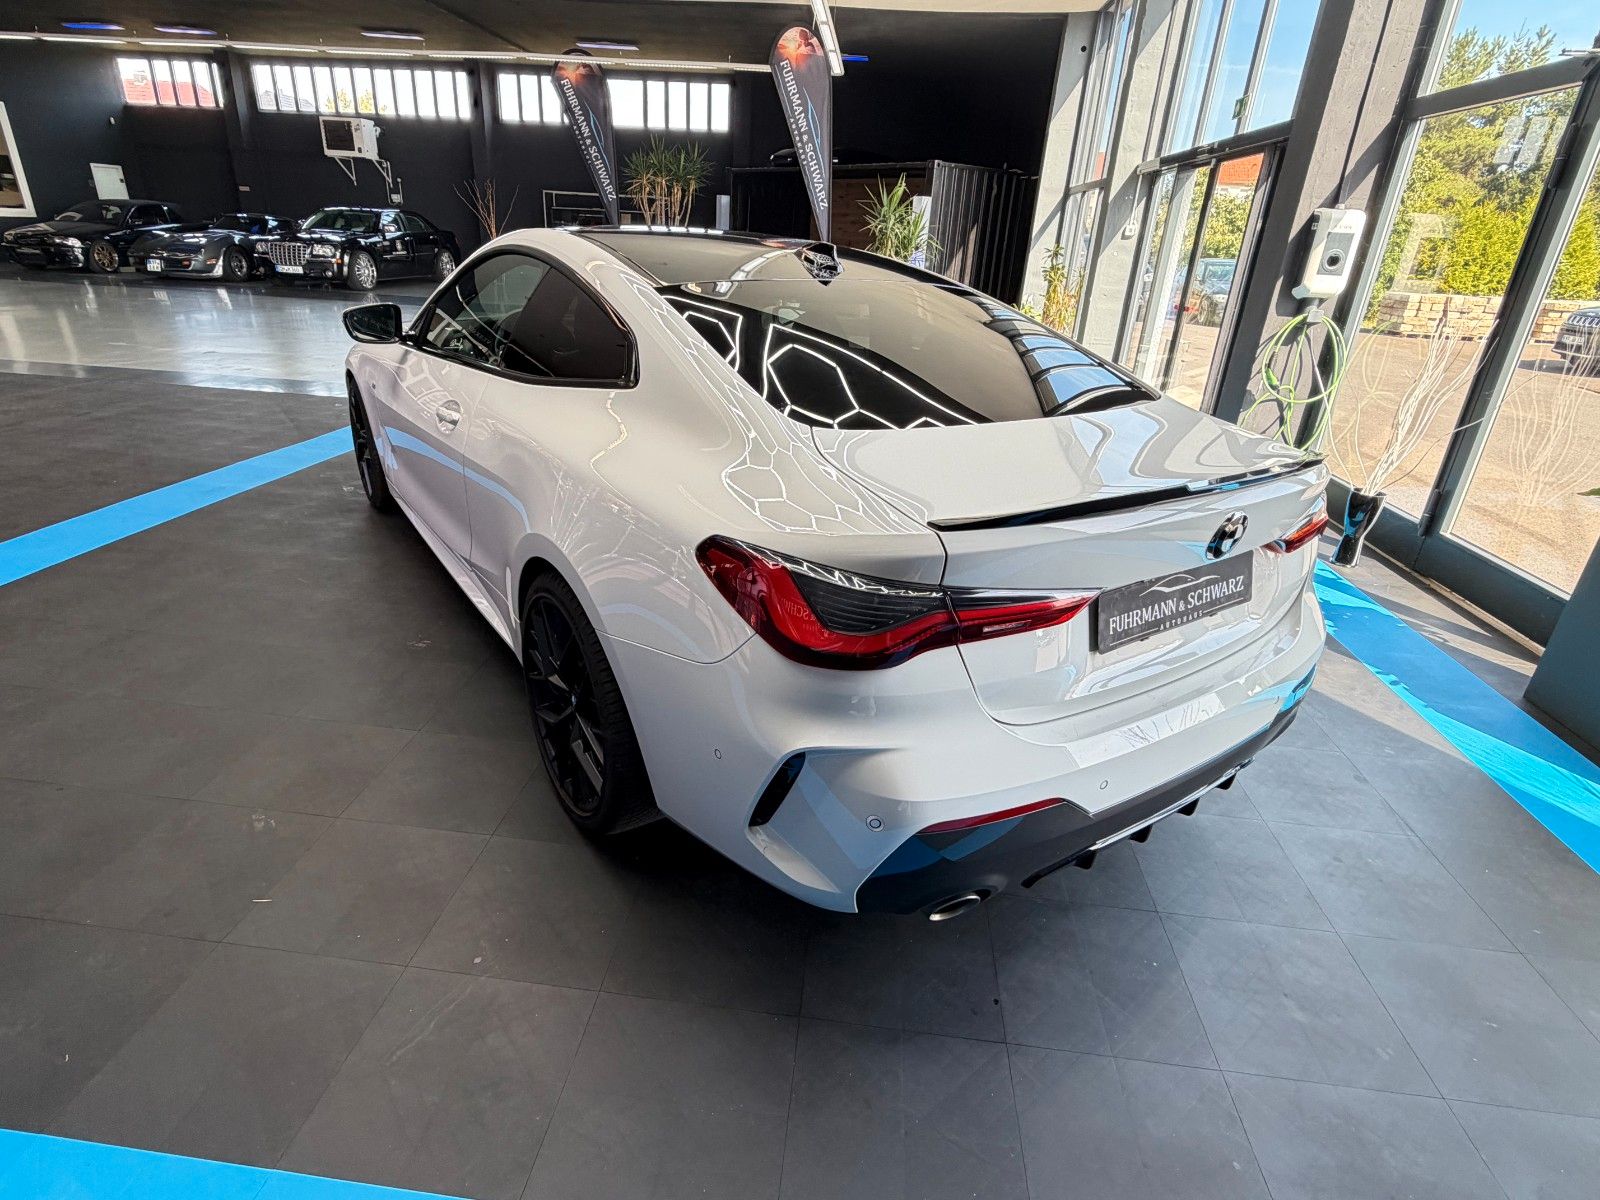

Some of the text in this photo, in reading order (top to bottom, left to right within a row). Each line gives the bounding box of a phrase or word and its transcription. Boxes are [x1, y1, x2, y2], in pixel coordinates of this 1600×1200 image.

[561, 79, 591, 137] FUHRMANN
[589, 146, 616, 201] SCHWARZ
[780, 59, 808, 132] FUHRMANN
[805, 143, 828, 210] SCHWARZ
[1109, 575, 1244, 635] FUHRMANN & SCHWARZ
[1159, 611, 1203, 631] AUTOHAUS
